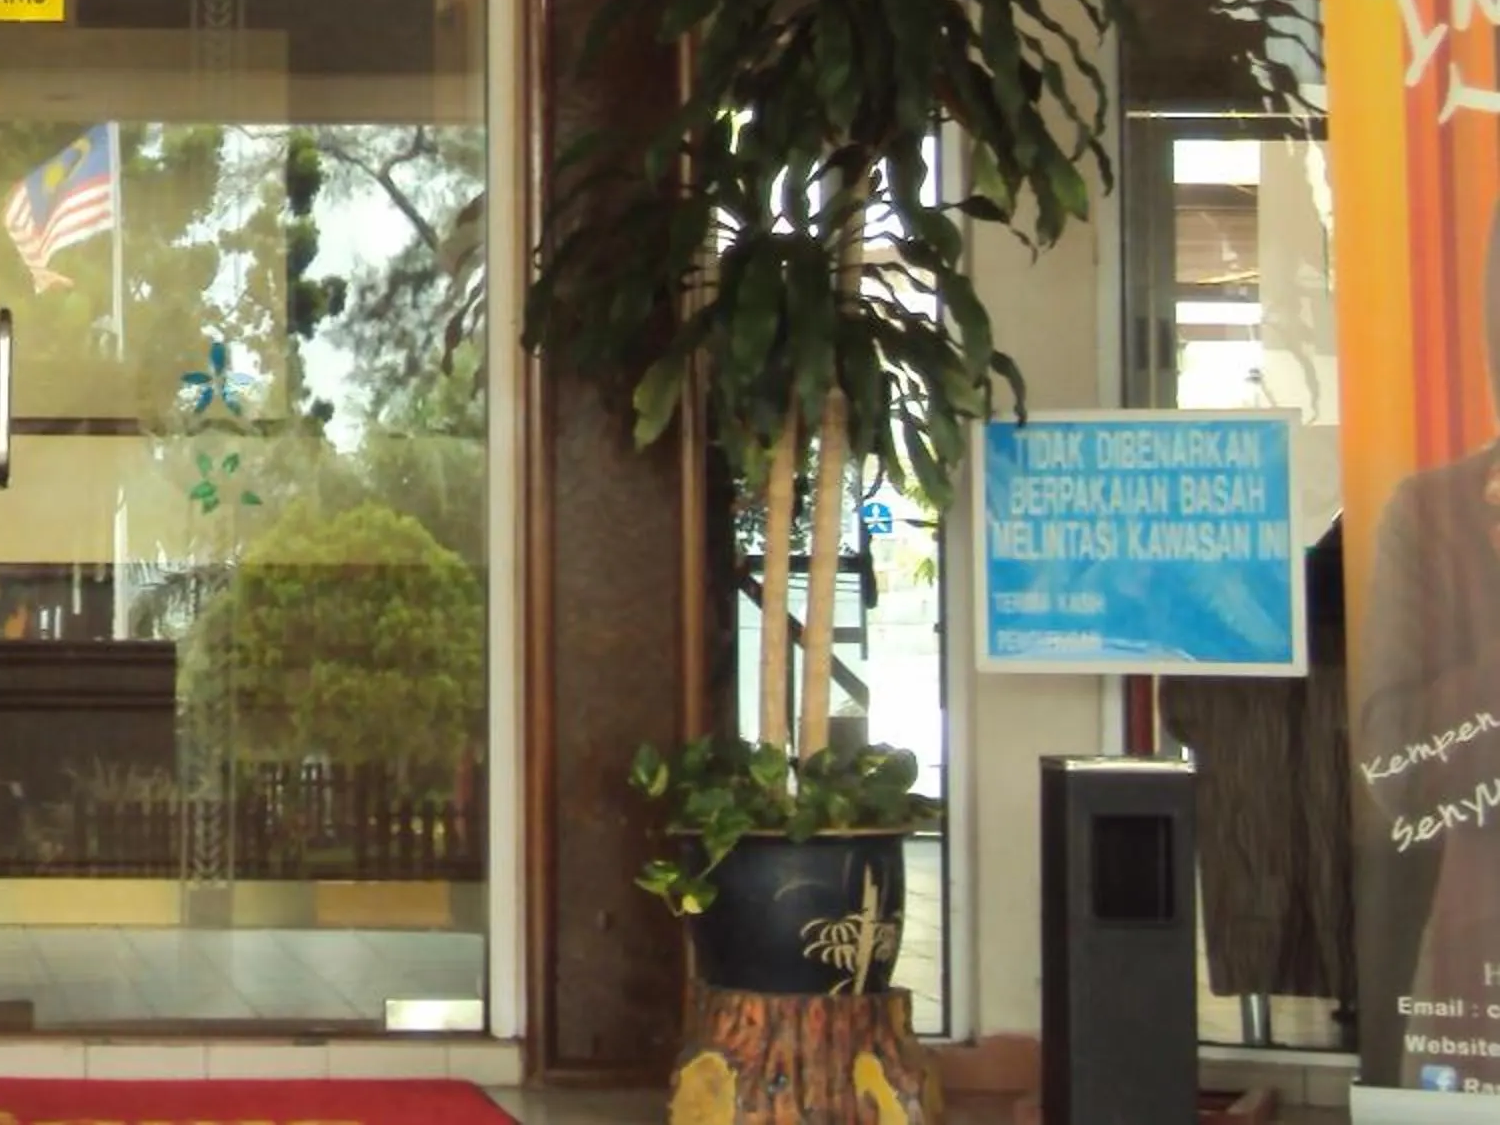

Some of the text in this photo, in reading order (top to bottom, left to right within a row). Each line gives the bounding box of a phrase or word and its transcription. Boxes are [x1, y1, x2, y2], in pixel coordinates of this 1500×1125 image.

[1012, 428, 1262, 470] TIDAK DIBENARKAN
[1009, 475, 1267, 516] BERPAKAIAN BASAH
[1126, 520, 1250, 562] KAWASAN
[1361, 712, 1500, 785] Kempen
[1397, 995, 1464, 1017] Email
[1404, 1033, 1500, 1058] Website
